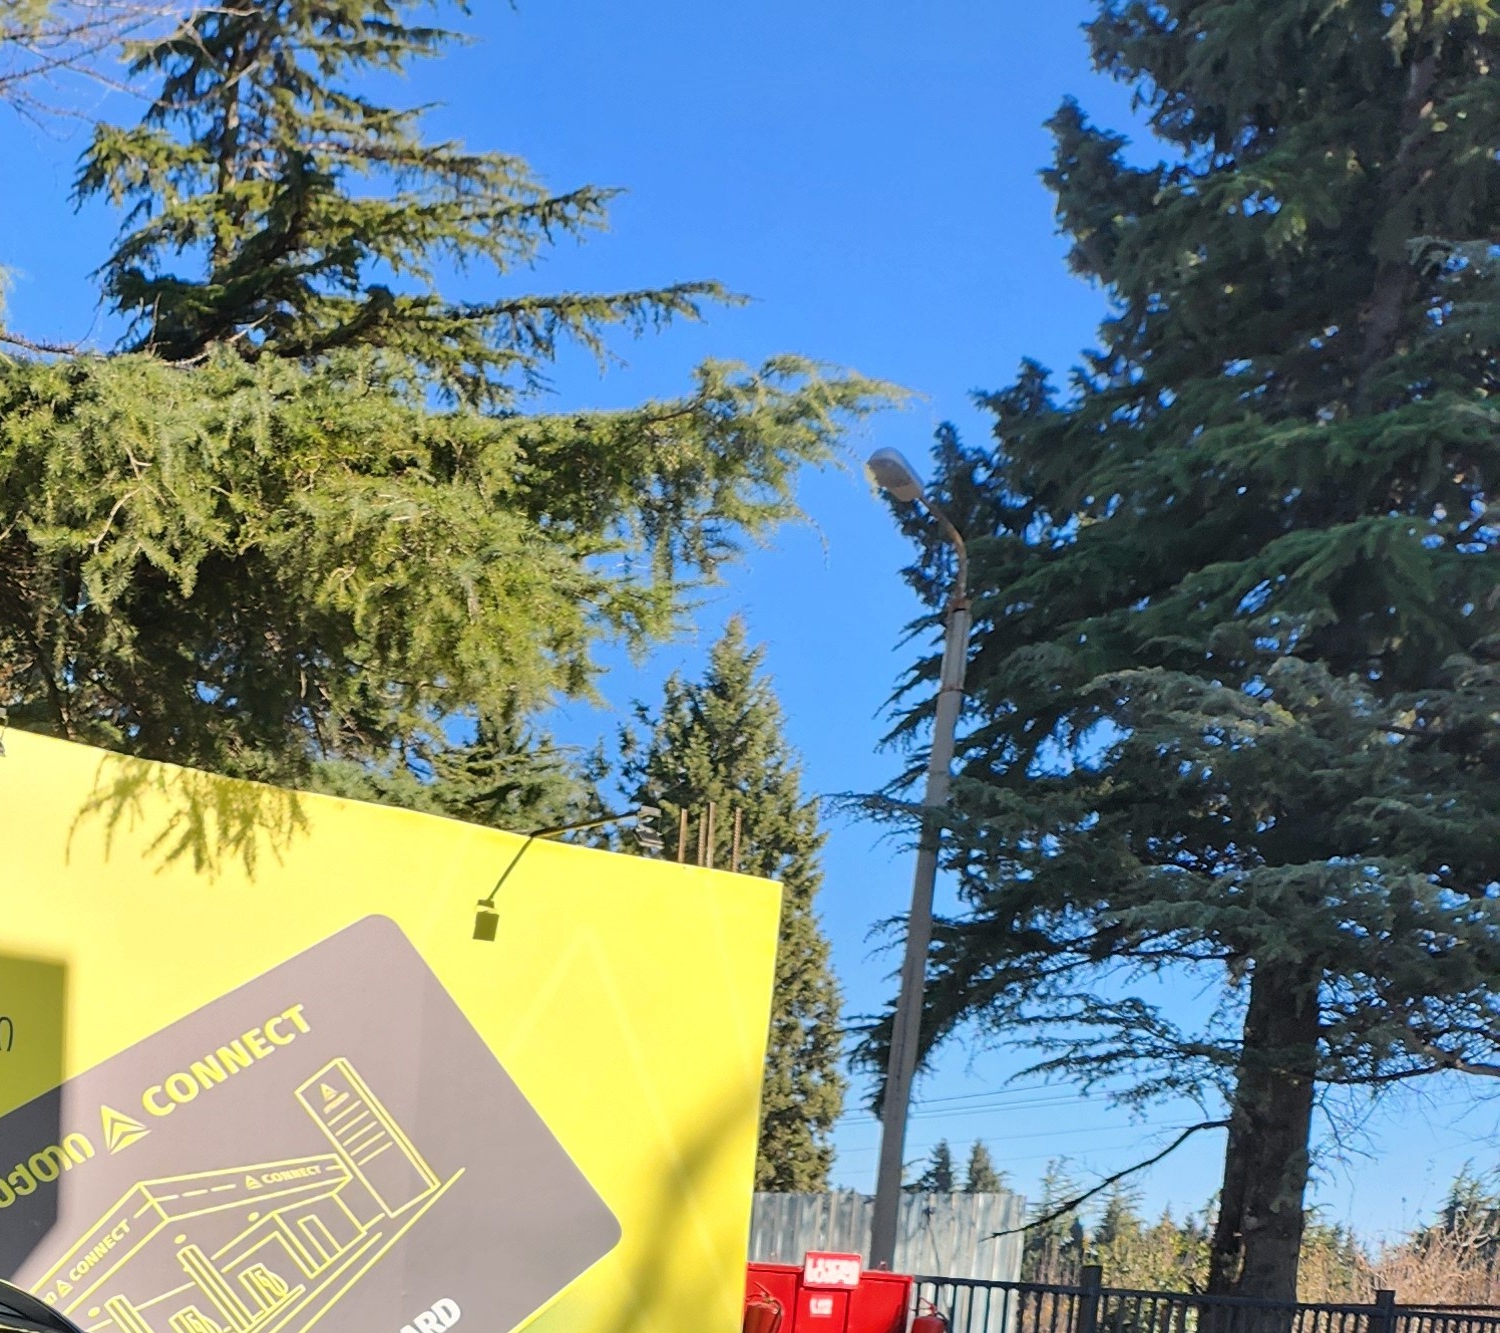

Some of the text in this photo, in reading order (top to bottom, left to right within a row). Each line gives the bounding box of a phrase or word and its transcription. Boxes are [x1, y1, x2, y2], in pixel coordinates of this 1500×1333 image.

[142, 1003, 311, 1117] CONNECT
[261, 1165, 322, 1184] CONNECT
[69, 1218, 131, 1281] CONNECT
